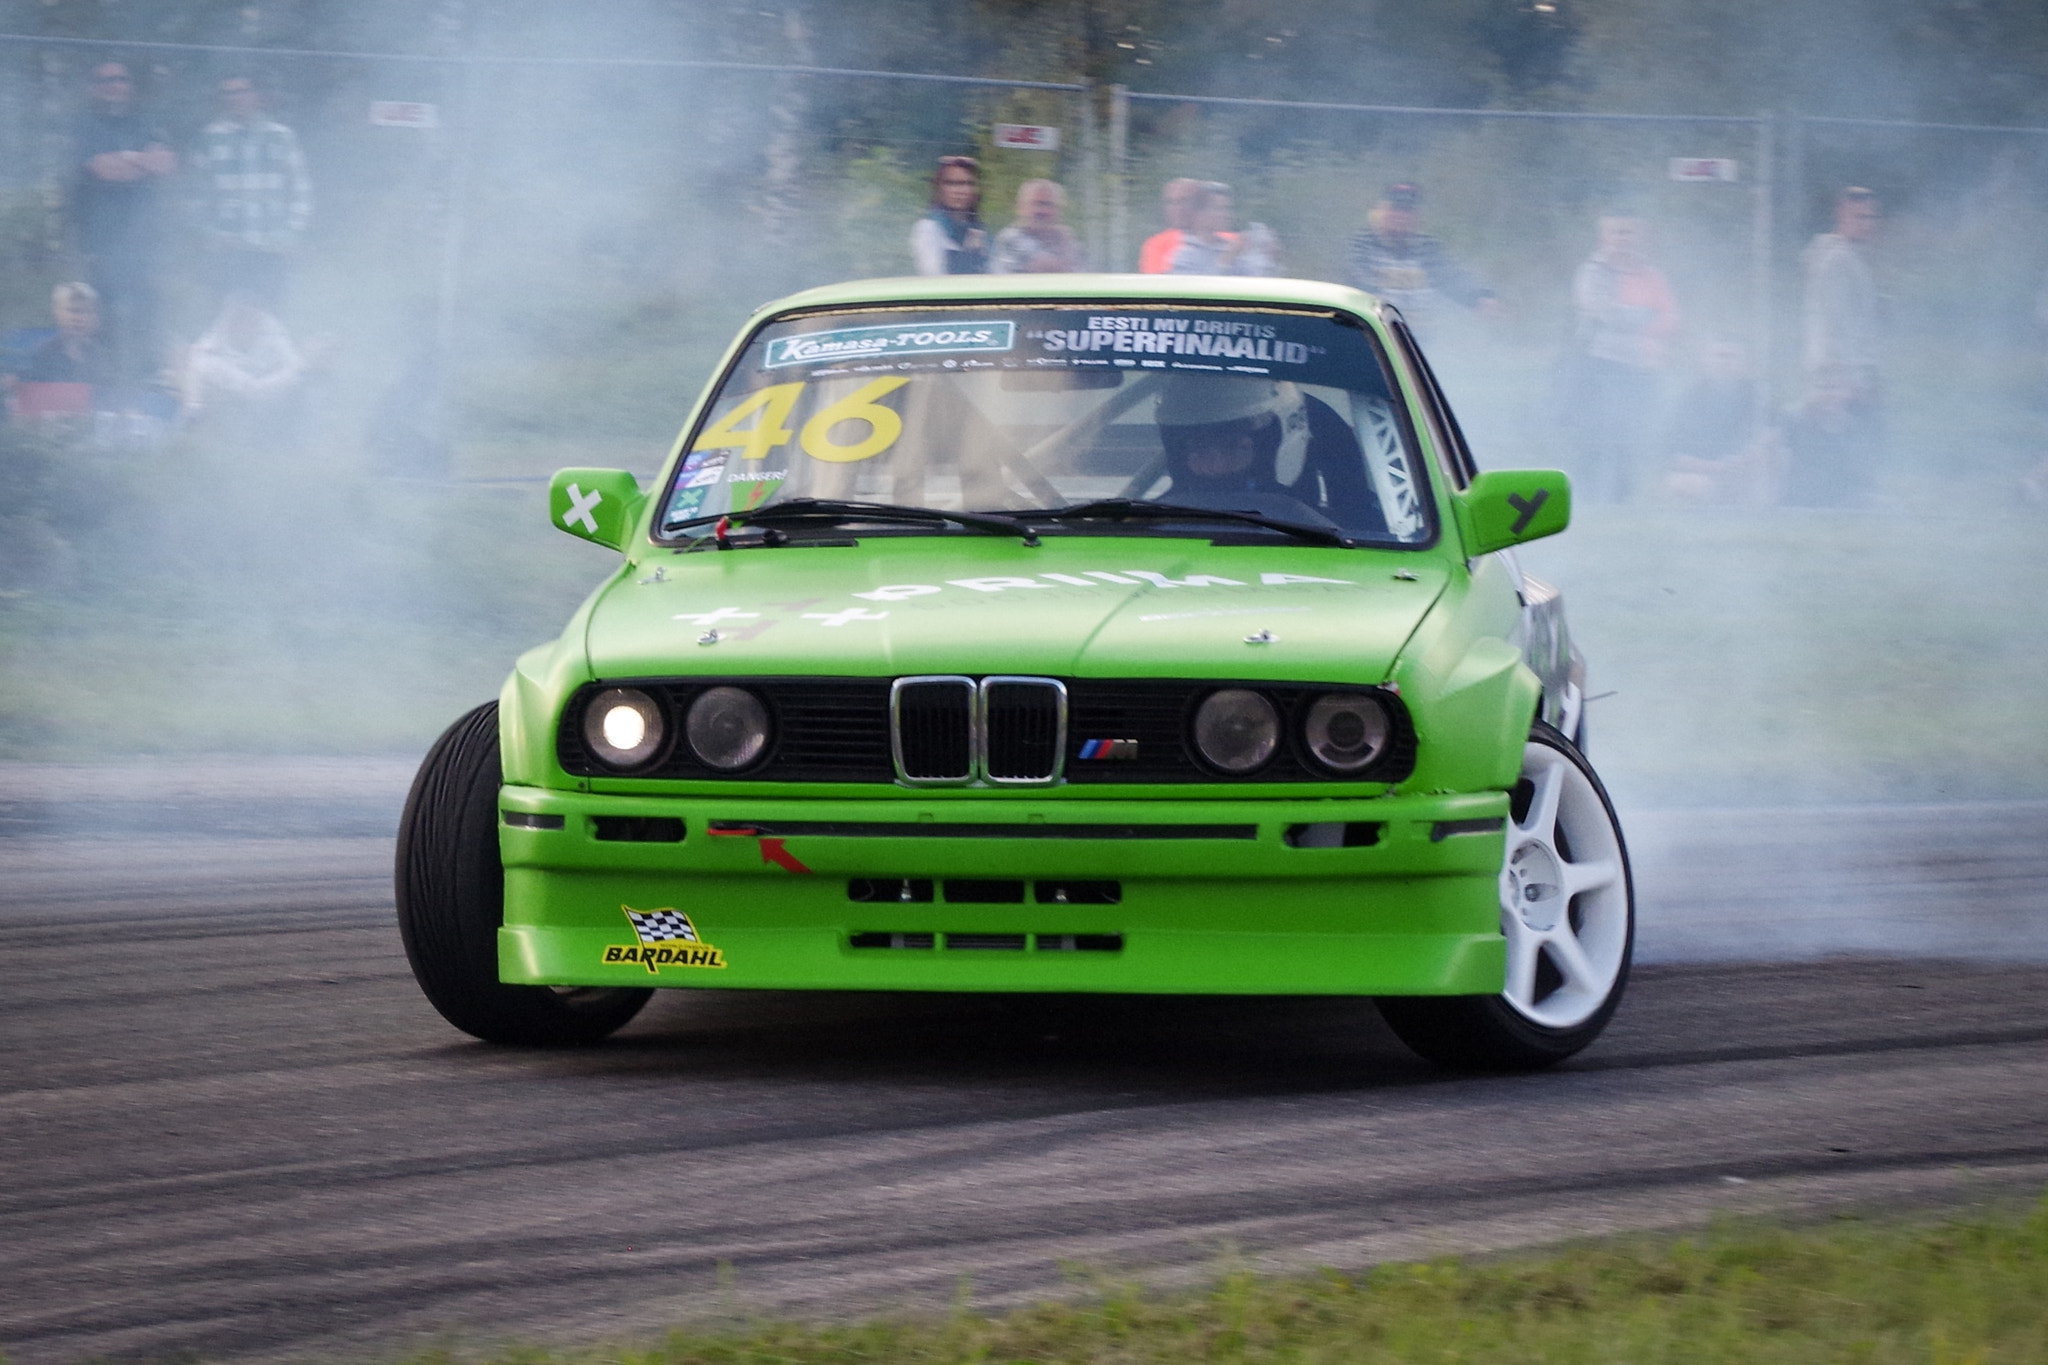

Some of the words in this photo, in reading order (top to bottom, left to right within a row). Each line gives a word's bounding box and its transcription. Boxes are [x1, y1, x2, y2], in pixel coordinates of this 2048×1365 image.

[1087, 316, 1148, 331] EESTI
[1153, 318, 1189, 333] MV
[1193, 320, 1276, 339] DRIFTIS
[692, 375, 911, 463] 46
[605, 947, 722, 972] BARDAHL
